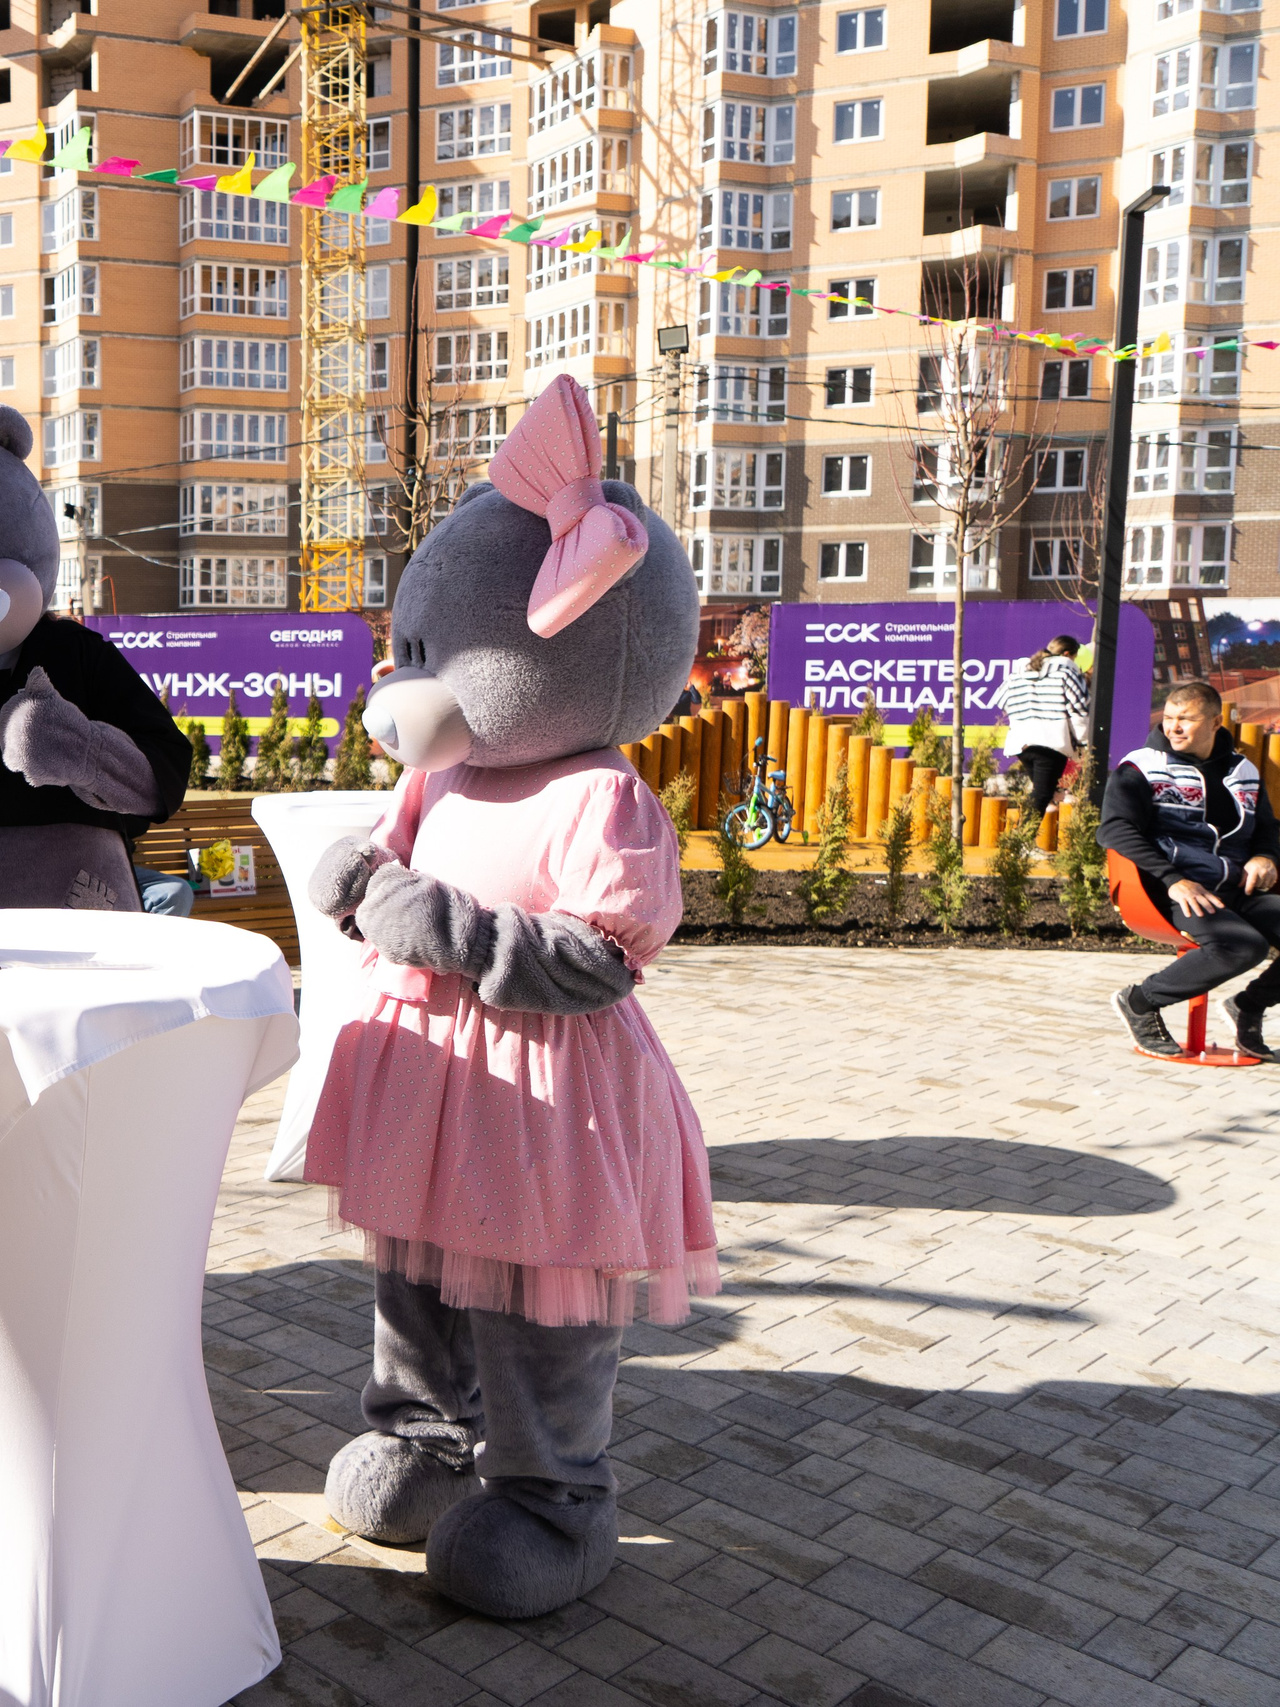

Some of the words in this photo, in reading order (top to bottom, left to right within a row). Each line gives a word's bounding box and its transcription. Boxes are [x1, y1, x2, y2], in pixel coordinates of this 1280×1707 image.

[885, 622, 956, 632] Строительная
[166, 631, 218, 640] Строительная
[270, 629, 343, 643] СЕГОДНЯ
[885, 633, 933, 643] компания
[166, 640, 202, 648] компания
